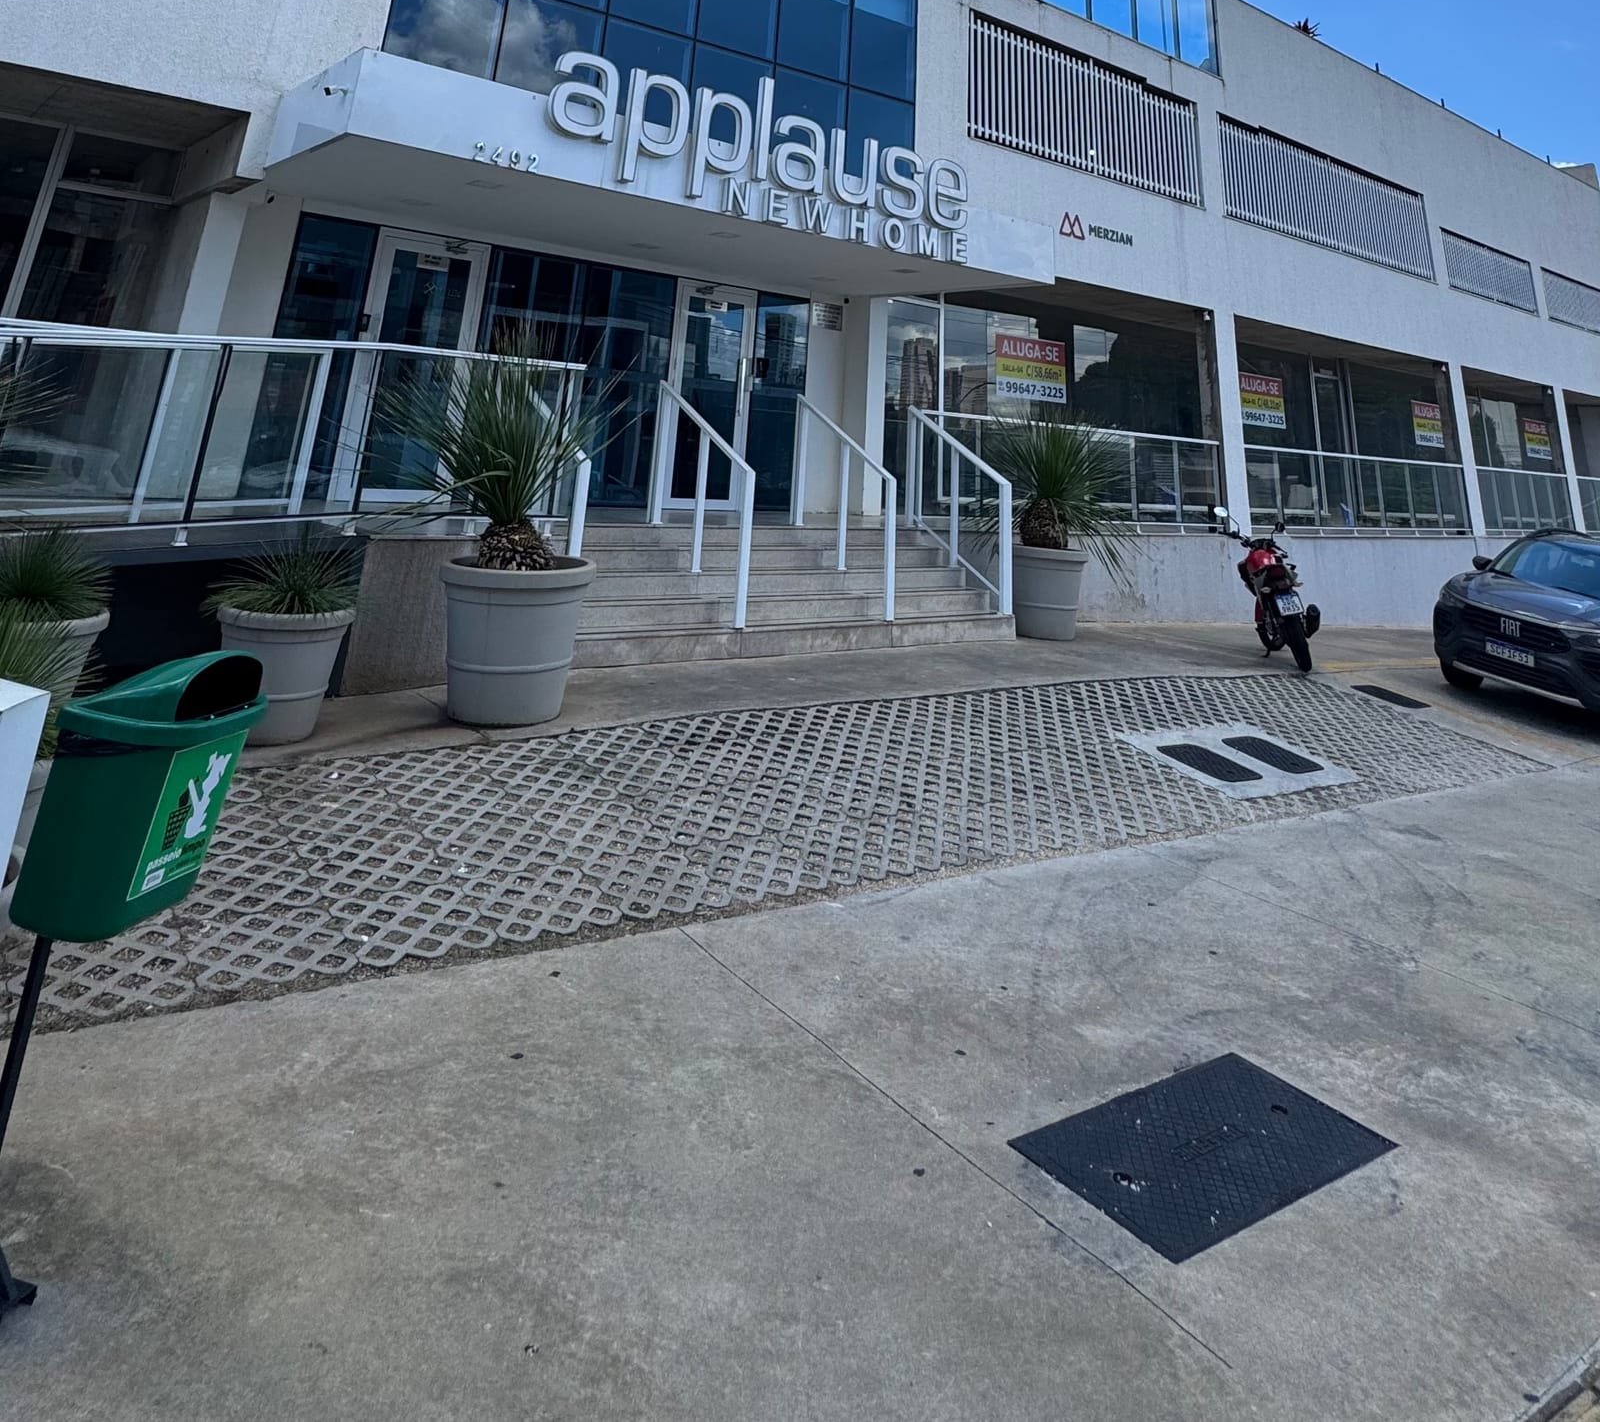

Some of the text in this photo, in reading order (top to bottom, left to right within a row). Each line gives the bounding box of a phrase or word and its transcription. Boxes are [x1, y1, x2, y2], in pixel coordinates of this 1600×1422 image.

[547, 51, 968, 230] applause
[473, 141, 540, 173] 2492
[1088, 223, 1133, 247] MERZIAN
[1002, 339, 1059, 362] ALUGA-SE
[1005, 381, 1064, 398] 99647-3225
[1241, 377, 1280, 395] ALUGA-SE
[1245, 411, 1285, 425] 99647-3225
[1501, 617, 1520, 637] FIAT
